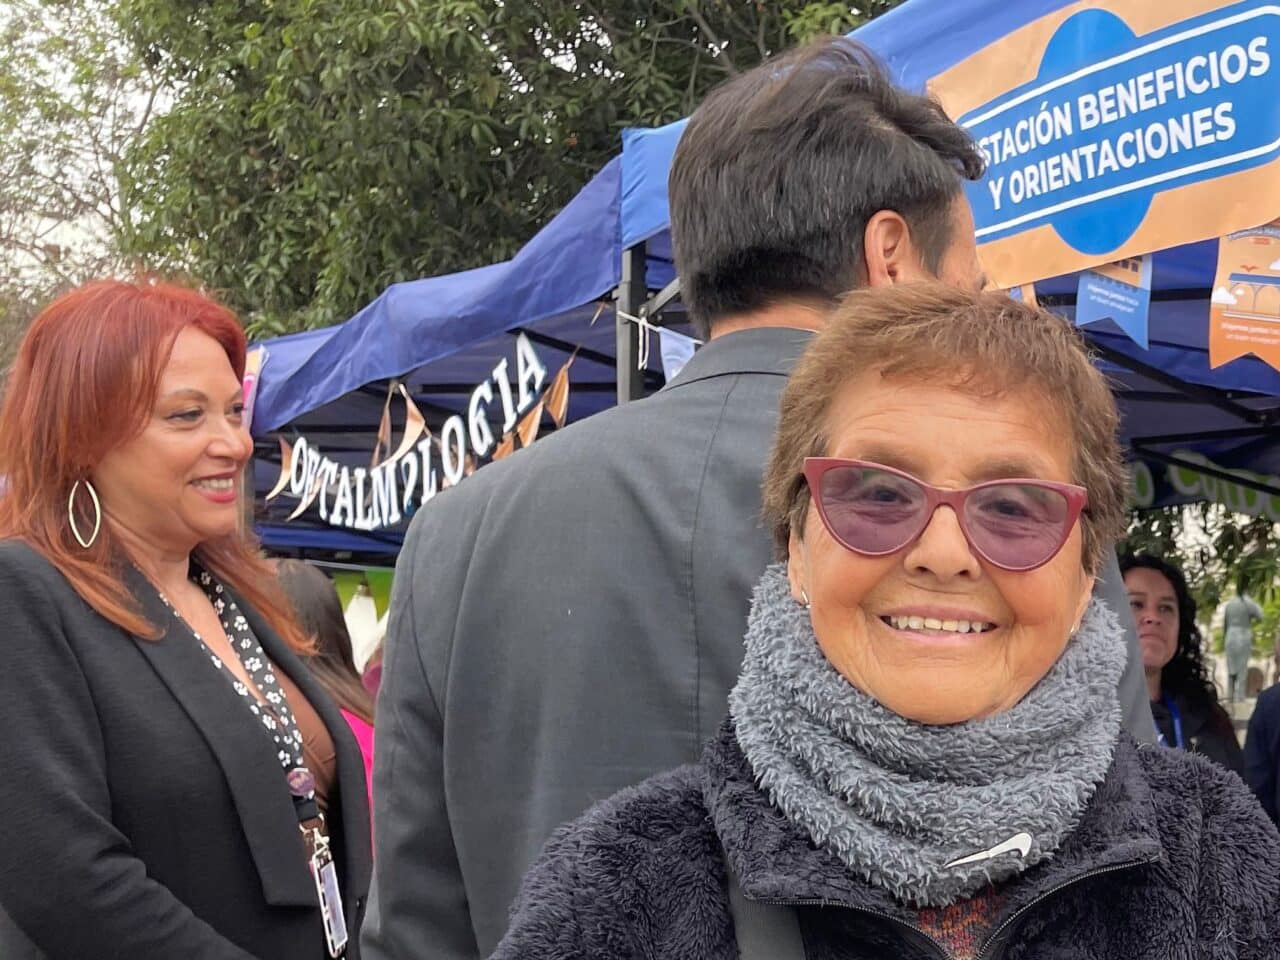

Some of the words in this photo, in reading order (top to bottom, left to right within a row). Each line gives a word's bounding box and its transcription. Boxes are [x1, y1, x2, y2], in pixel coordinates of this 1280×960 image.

[972, 102, 1072, 167] STACIÓN
[1078, 36, 1271, 131] BENEFICIOS
[988, 176, 1005, 210] Y
[1009, 102, 1237, 205] ORIENTACIONES
